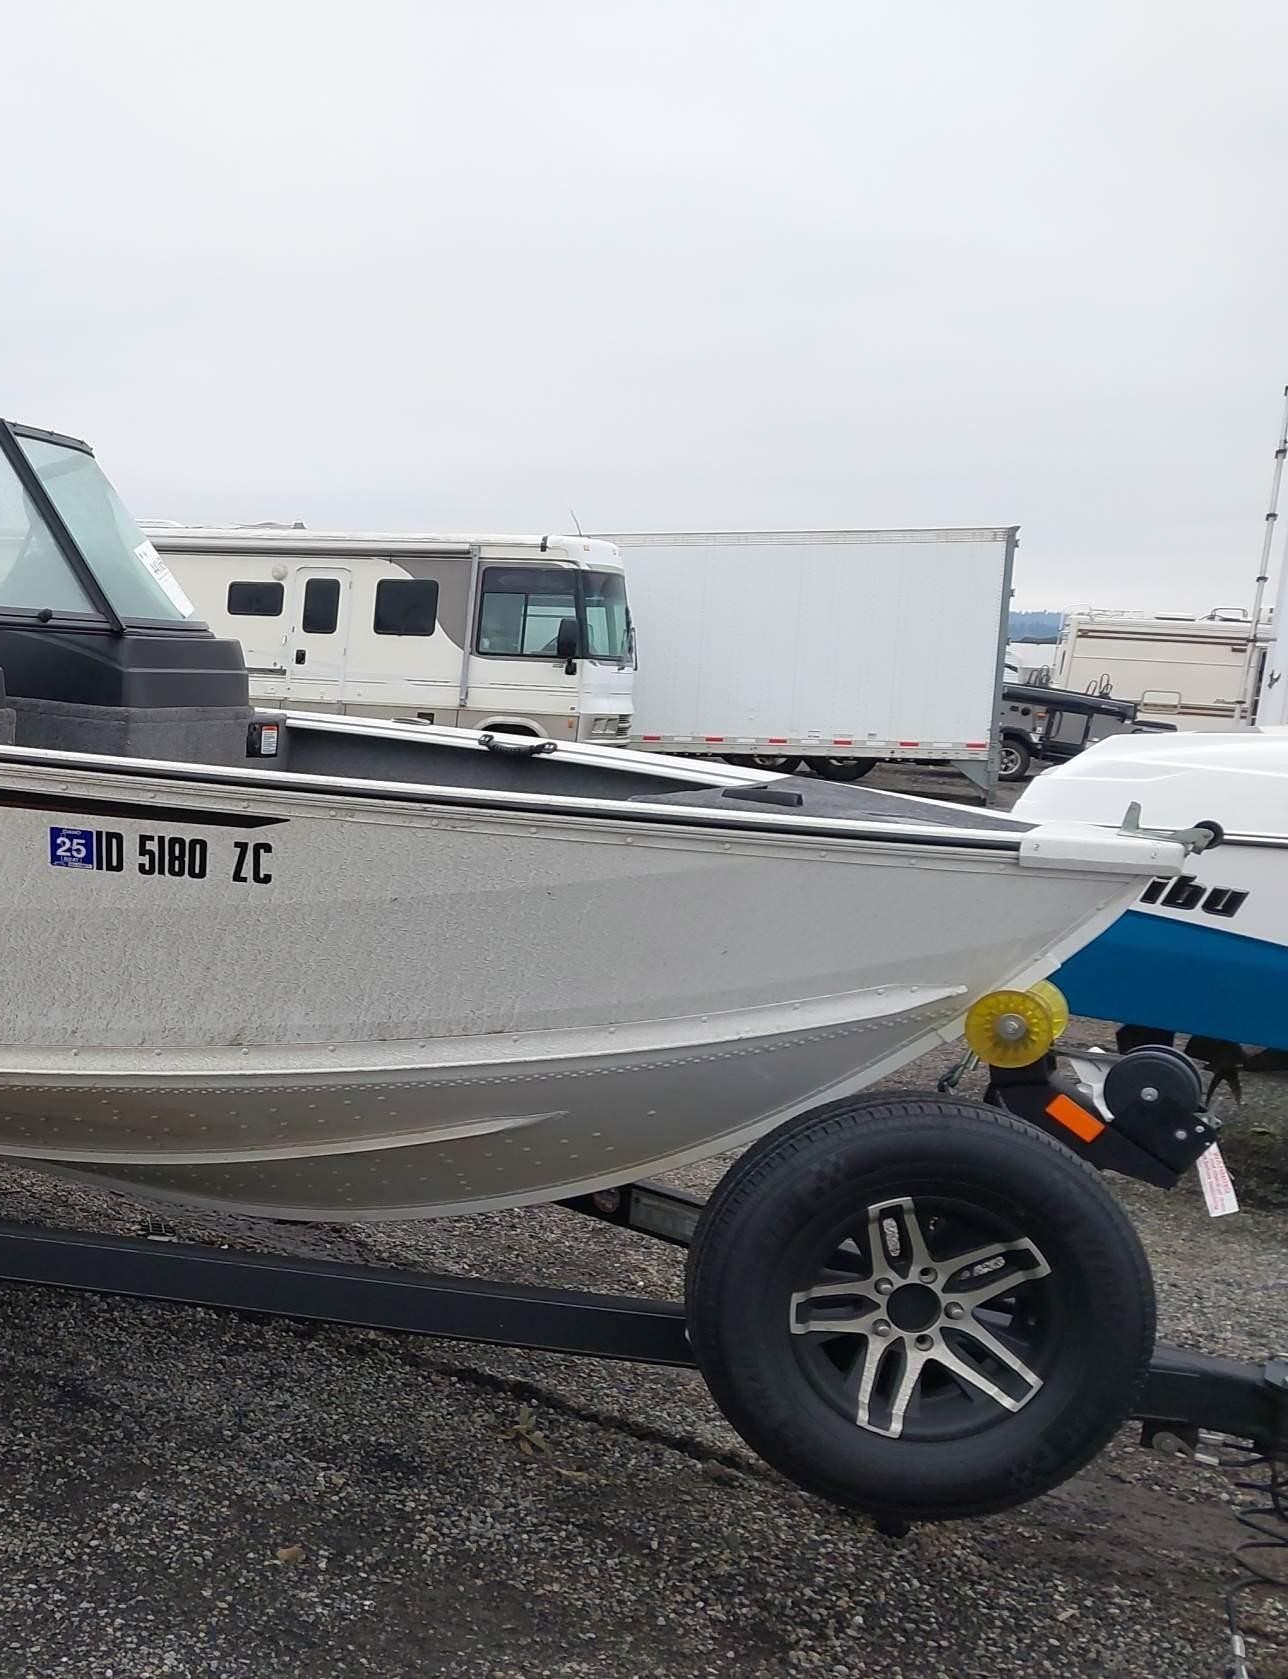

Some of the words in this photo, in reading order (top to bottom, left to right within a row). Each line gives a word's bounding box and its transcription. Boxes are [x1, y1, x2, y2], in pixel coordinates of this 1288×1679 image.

[56, 836, 87, 858] 25
[96, 831, 124, 873] ID
[138, 834, 208, 879] 5180
[232, 841, 273, 884] ZC
